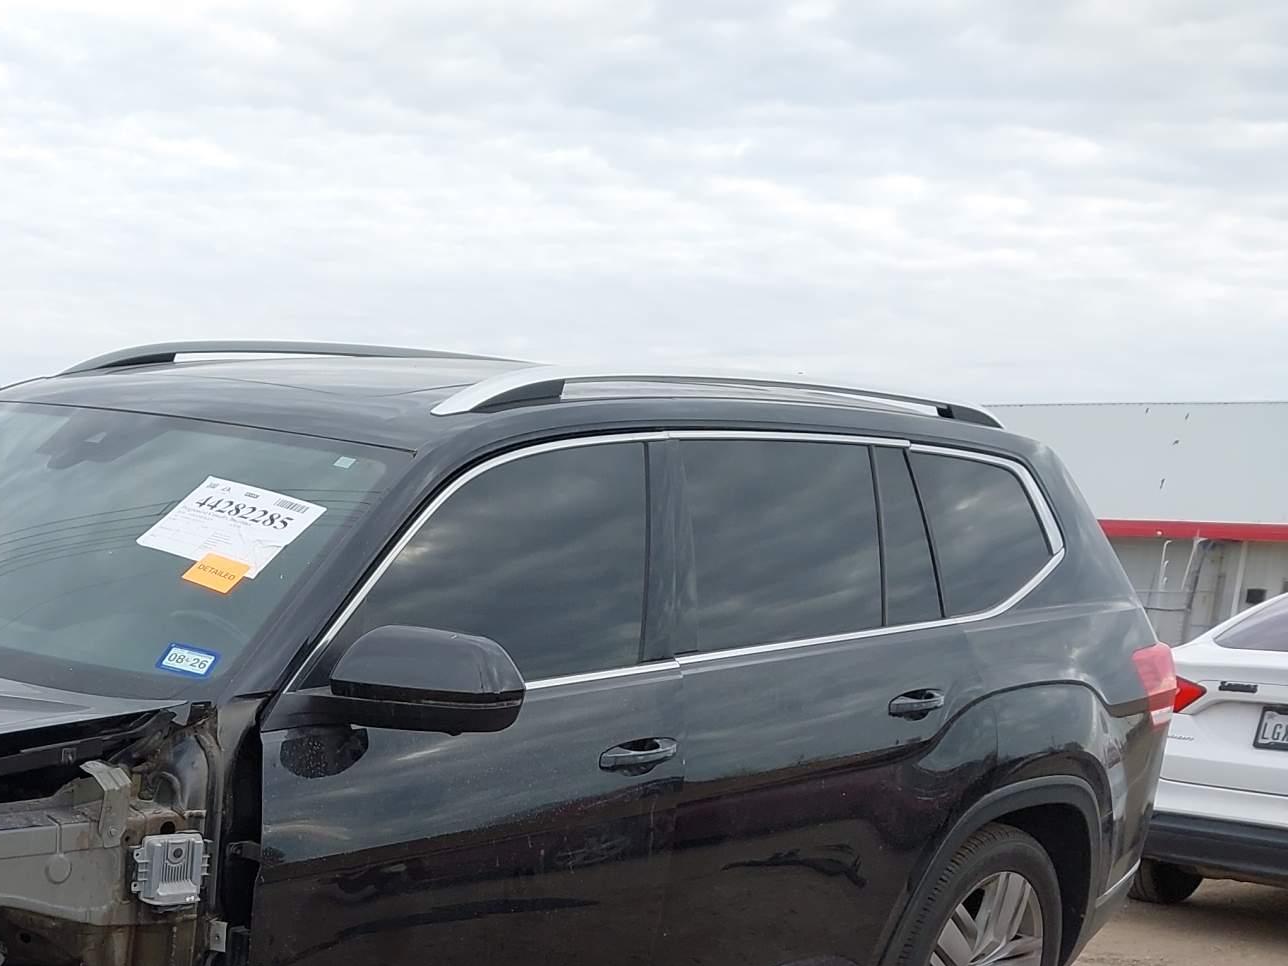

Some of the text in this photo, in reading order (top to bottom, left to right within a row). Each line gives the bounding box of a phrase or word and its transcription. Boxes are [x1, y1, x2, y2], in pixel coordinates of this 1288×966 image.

[196, 495, 294, 530] 44282285
[197, 562, 236, 581] DETAILED
[168, 652, 209, 670] 08 26
